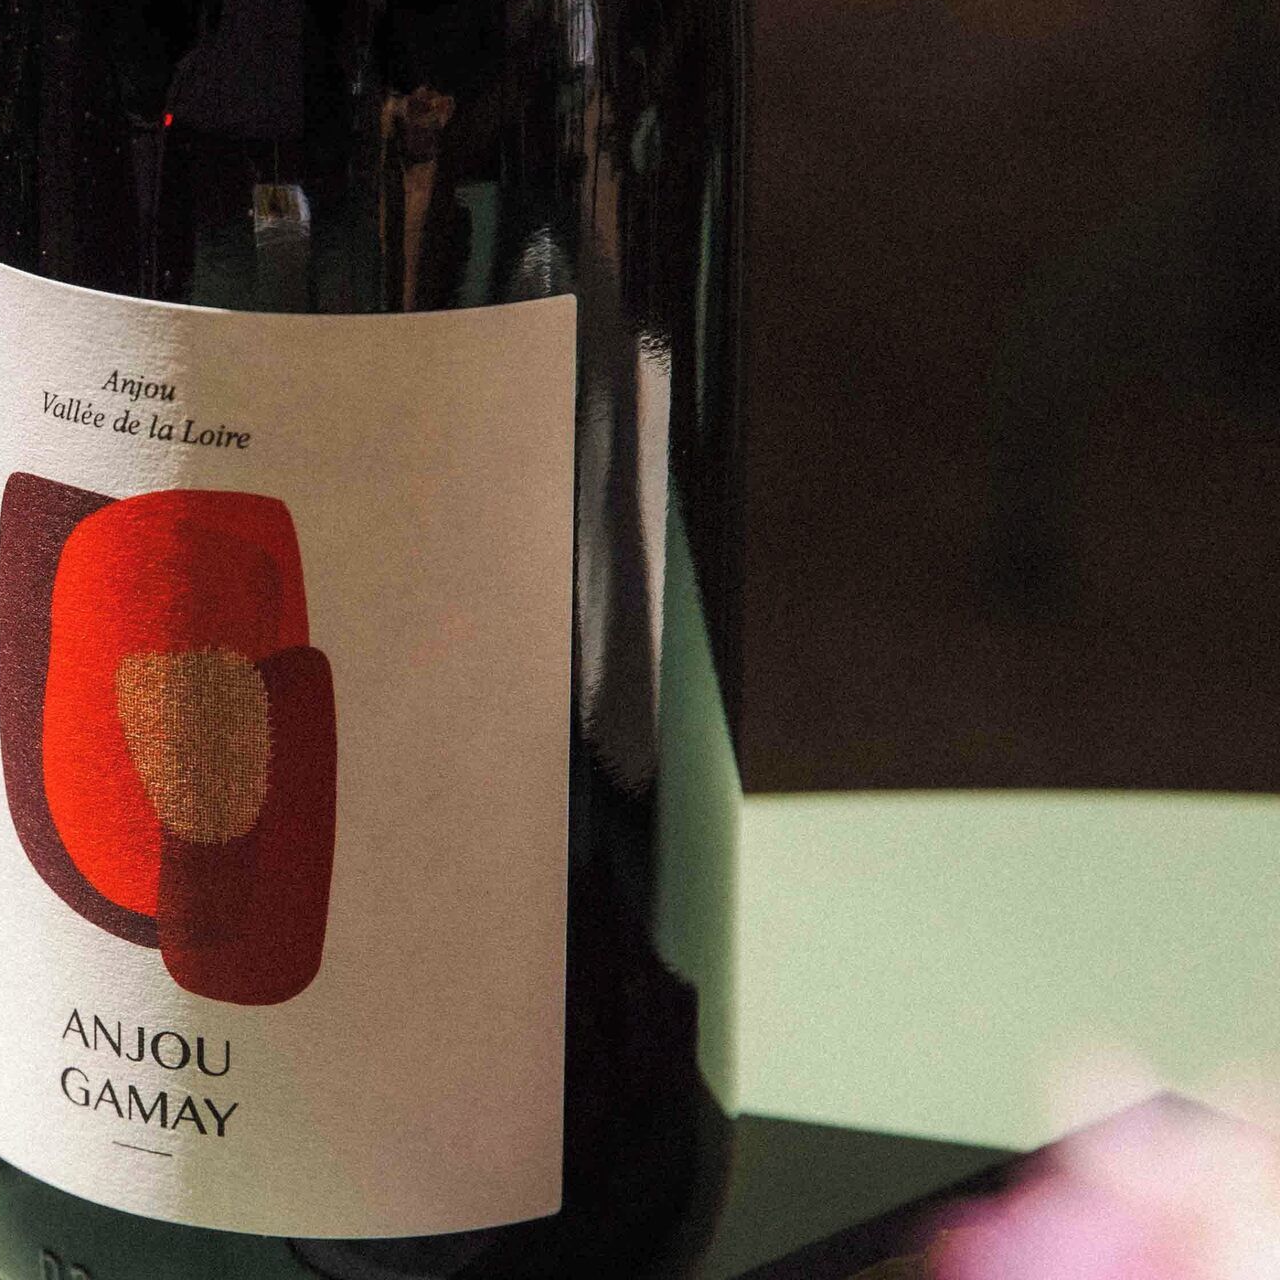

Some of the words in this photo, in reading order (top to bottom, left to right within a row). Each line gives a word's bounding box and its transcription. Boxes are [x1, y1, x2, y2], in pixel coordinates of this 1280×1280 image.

[101, 370, 176, 402] Anjou
[42, 391, 105, 428] Vallée
[113, 410, 140, 436] de
[149, 415, 173, 441] la
[182, 420, 252, 449] Loire
[62, 1008, 230, 1076] ANJOU
[61, 1067, 239, 1137] GAMAY
